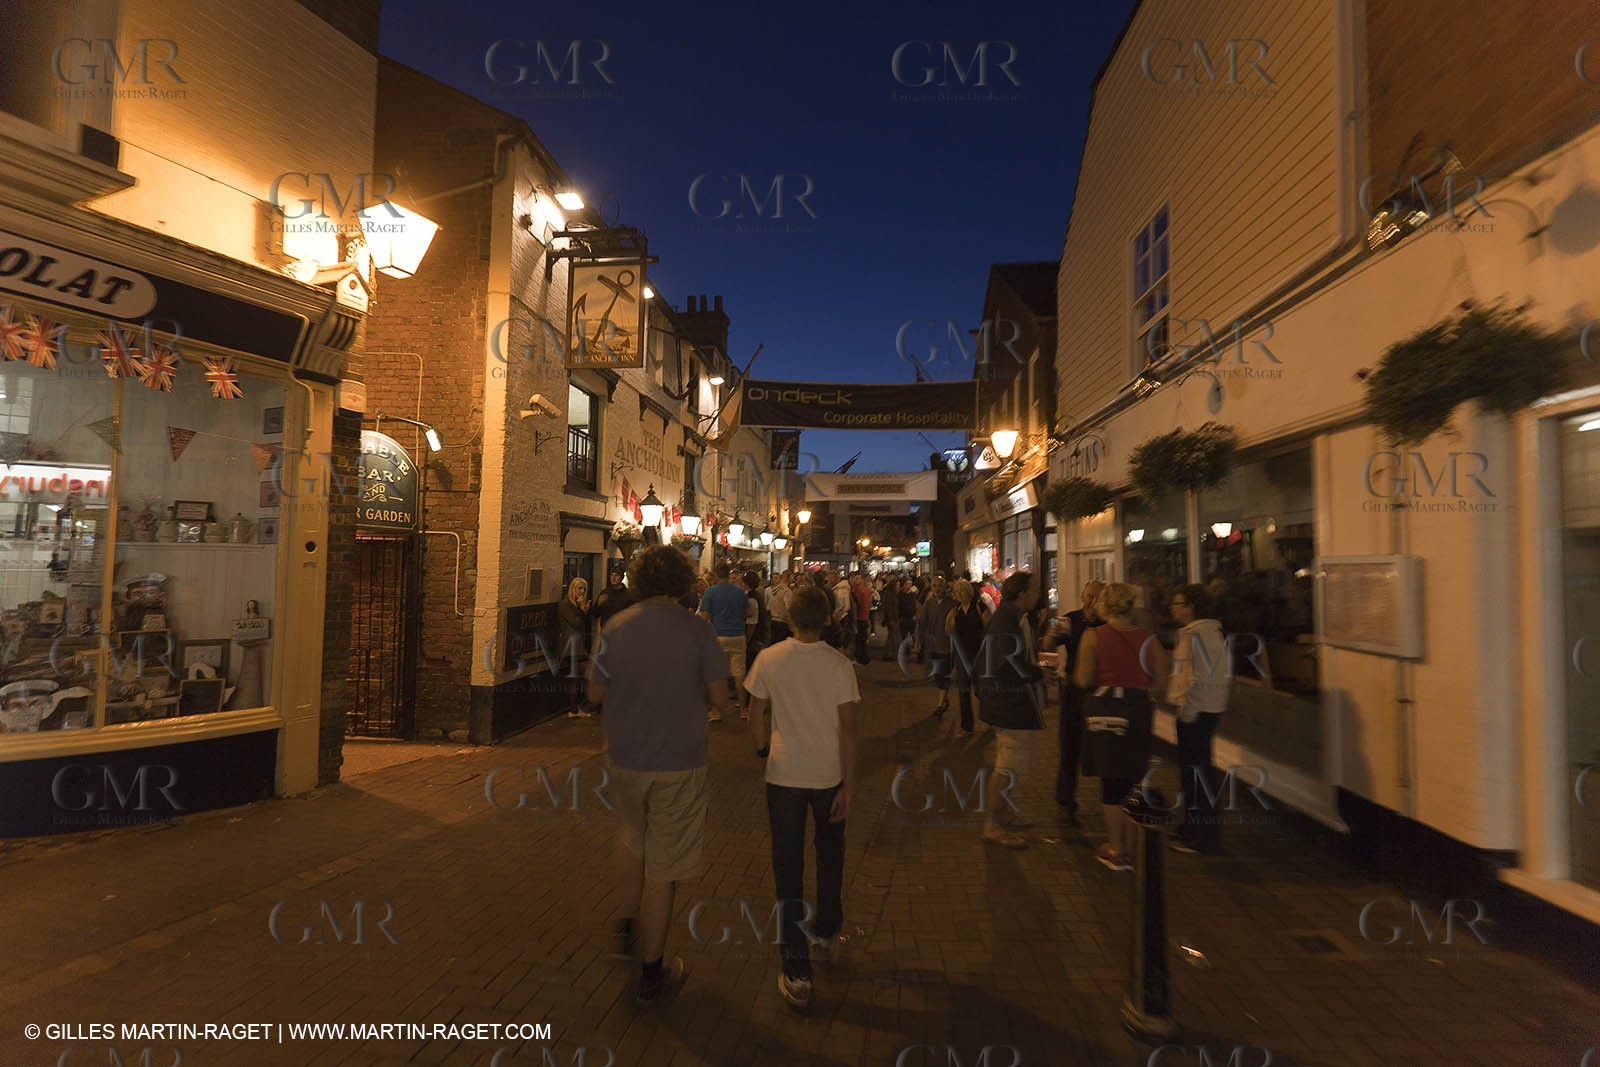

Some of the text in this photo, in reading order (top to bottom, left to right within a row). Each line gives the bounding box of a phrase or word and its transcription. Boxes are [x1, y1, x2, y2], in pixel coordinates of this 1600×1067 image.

[748, 387, 852, 405] ondeck
[823, 410, 969, 425] Corporate Hospitality
[642, 430, 661, 453] THE
[614, 436, 681, 484] ANCHOR INN
[364, 485, 386, 499] AND
[365, 507, 412, 523] GARDEN
